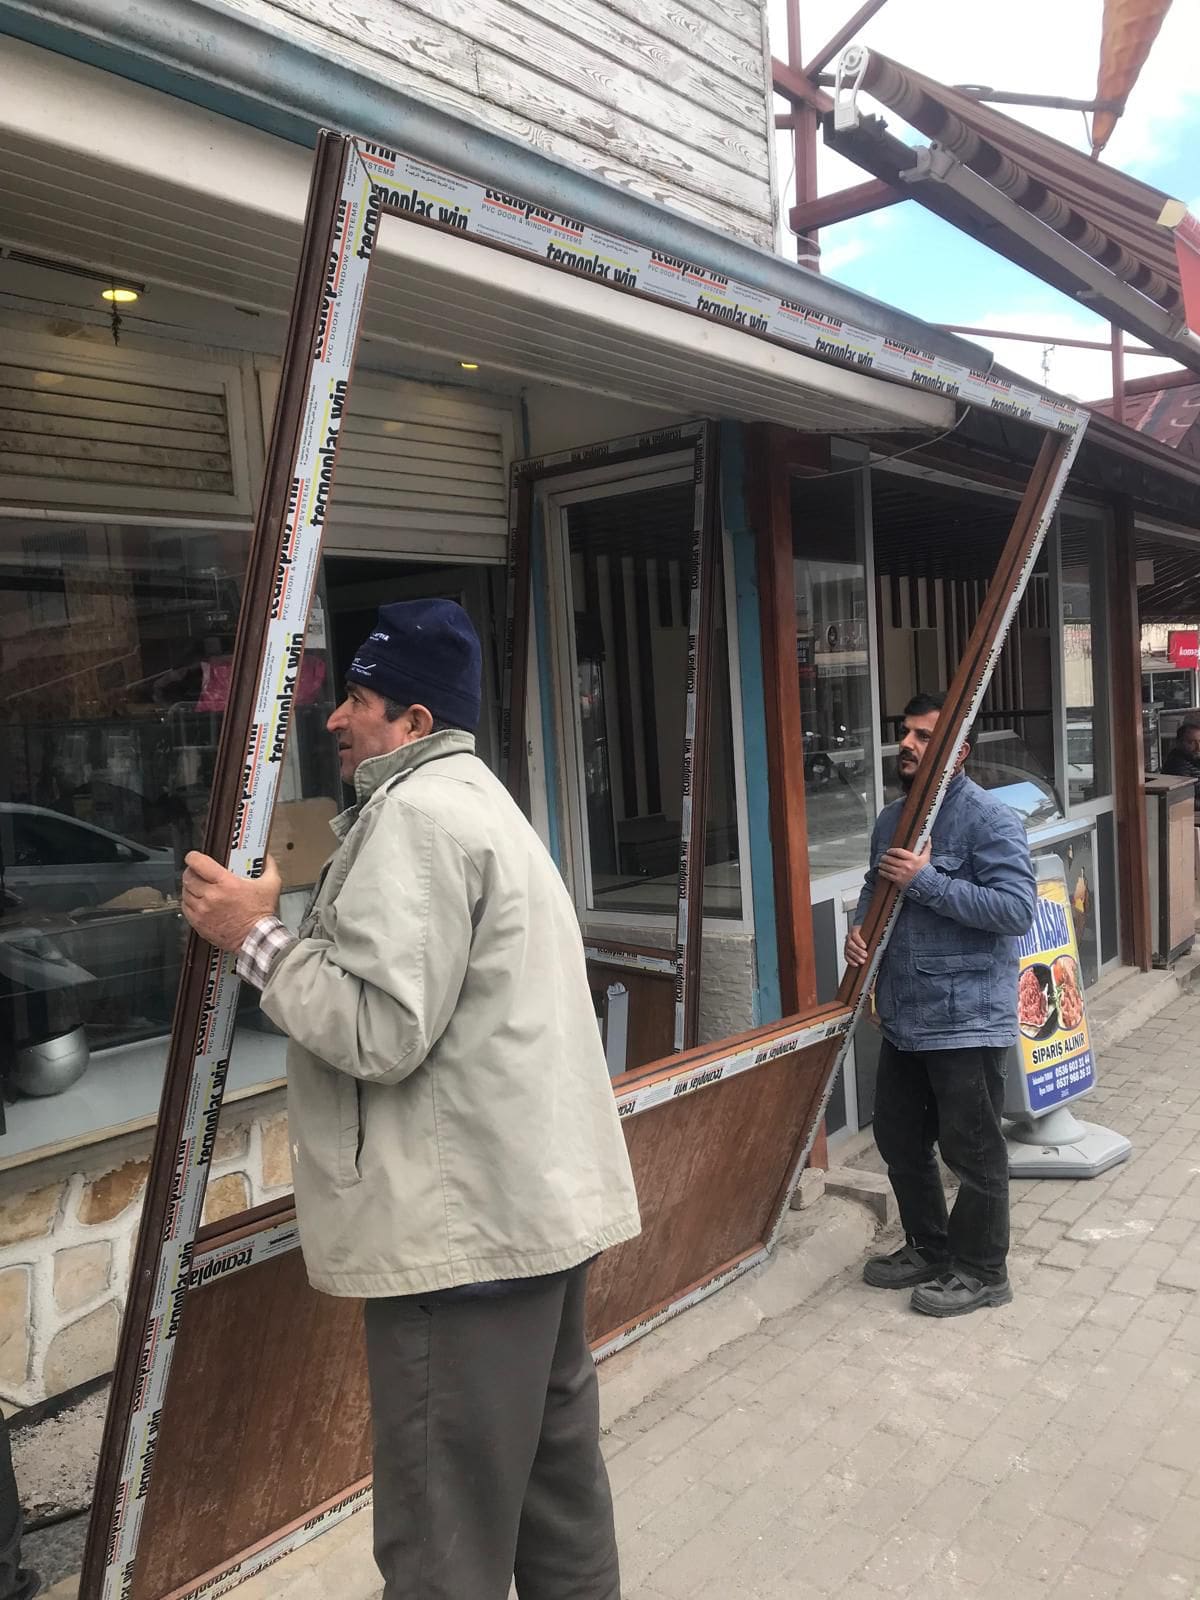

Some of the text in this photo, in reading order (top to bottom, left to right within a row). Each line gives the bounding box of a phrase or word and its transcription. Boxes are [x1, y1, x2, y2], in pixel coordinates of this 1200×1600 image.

[326, 338, 334, 363] PVC
[330, 311, 339, 335] DOOR
[337, 253, 349, 297] WINDOW
[346, 202, 358, 250] SYSTEMS
[329, 380, 347, 420] win
[299, 478, 310, 521] SYSTEMS
[292, 523, 302, 562] WINDOW
[285, 573, 294, 598] DOOR
[282, 606, 290, 620] PVC
[286, 633, 304, 669] win
[1065, 1033, 1085, 1053] ALINIR
[673, 1081, 687, 1096] win
